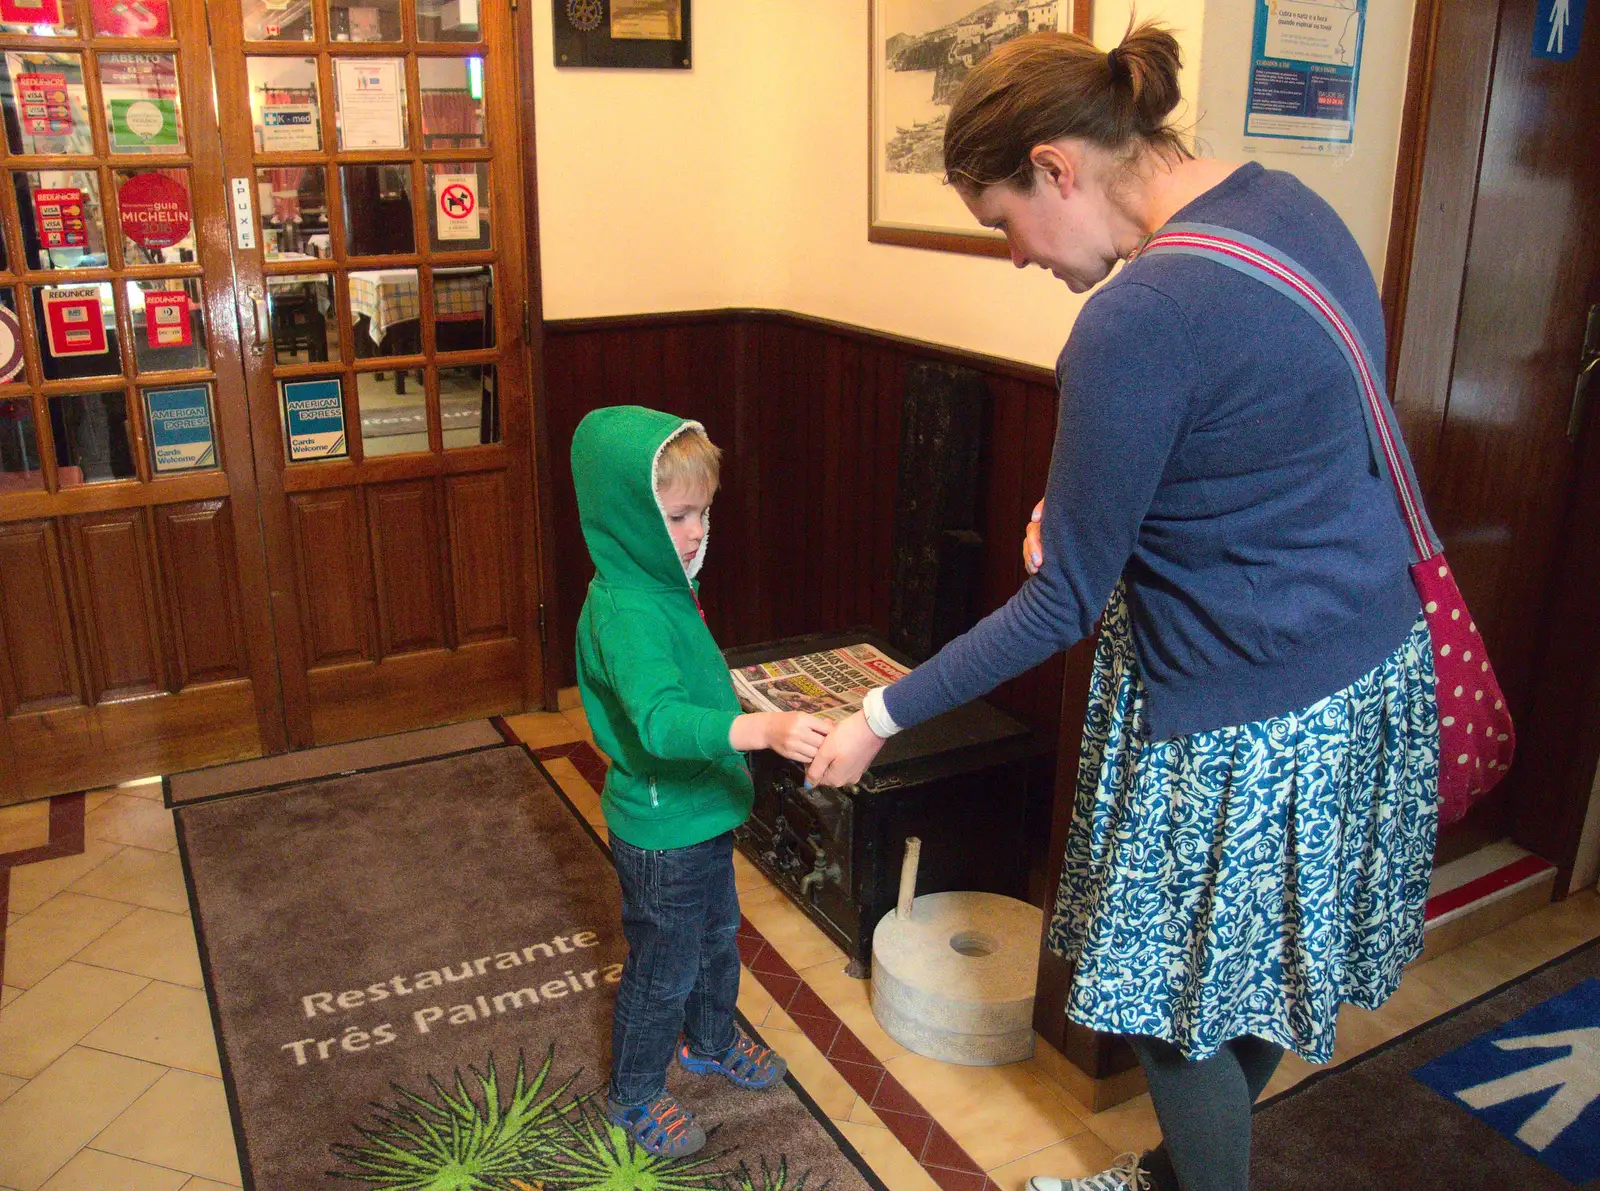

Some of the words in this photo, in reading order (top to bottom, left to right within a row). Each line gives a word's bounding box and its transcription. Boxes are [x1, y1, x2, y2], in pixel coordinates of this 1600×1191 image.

[111, 54, 160, 64] ABERTO
[153, 202, 178, 212] guia
[122, 211, 189, 223] MICHELIN
[237, 187, 250, 240] PUXE
[288, 397, 338, 411] AMERICAN
[151, 407, 205, 420] AMERICAN
[300, 408, 342, 420] EXPRESS
[164, 417, 210, 430] EXPRESS
[292, 438, 315, 446] Cards
[157, 449, 181, 457] Cards
[293, 444, 328, 453] Welcome
[157, 456, 196, 465] Welcome
[302, 931, 600, 1018] Restaurante
[281, 1023, 397, 1066] Três
[413, 963, 624, 1033] Palmeira
